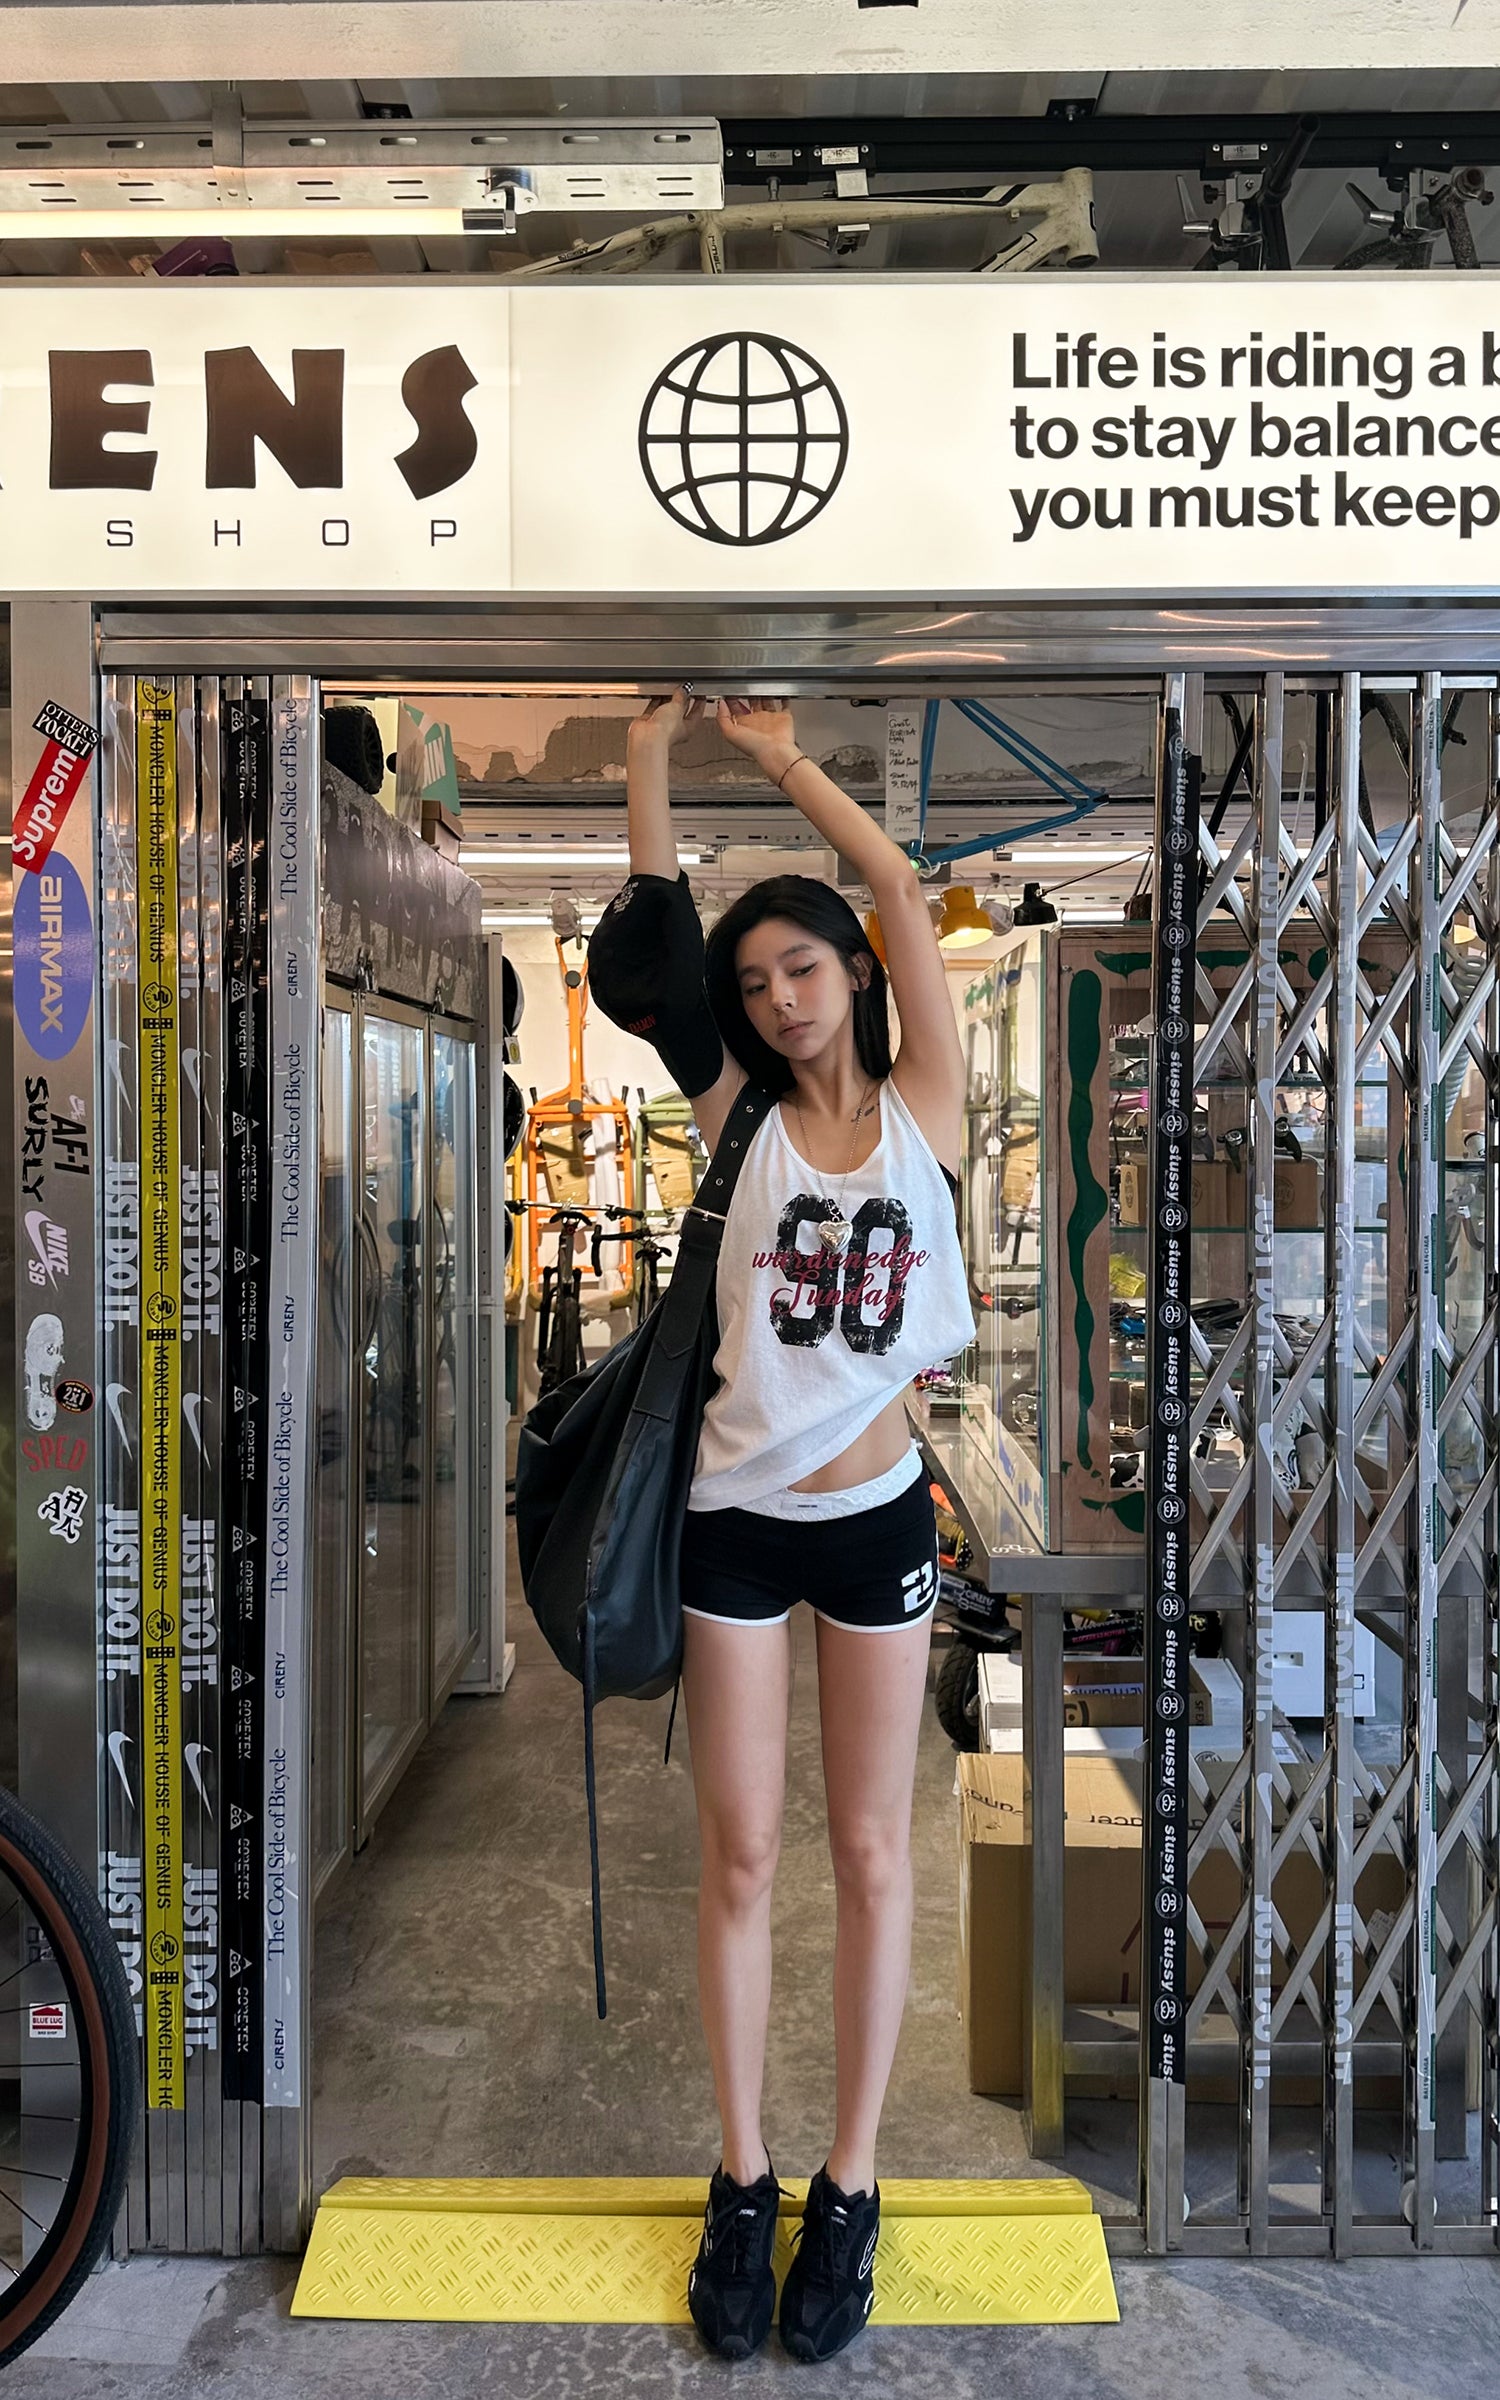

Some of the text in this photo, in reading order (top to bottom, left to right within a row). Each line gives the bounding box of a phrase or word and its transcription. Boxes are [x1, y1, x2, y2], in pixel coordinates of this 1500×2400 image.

[1012, 332, 1138, 389] Life
[1153, 332, 1206, 389] is
[1221, 331, 1413, 400] riding
[1428, 345, 1467, 388] a
[49, 345, 478, 500] ENS
[1010, 405, 1079, 459] to
[1092, 405, 1236, 470] stay
[107, 520, 457, 547] SHOP
[1009, 471, 1500, 543] you must keep
[36, 713, 93, 757] POCKET
[45, 703, 99, 744] OTTER'S
[280, 699, 301, 900] The Cool Side of Bicycle
[1173, 768, 1188, 825] stussy
[1171, 862, 1186, 920] stussy
[287, 951, 298, 995] CIRENS
[1169, 956, 1184, 1013] stussy
[1169, 1051, 1183, 1108] stussy
[21, 1075, 50, 1203] SURLY
[50, 1114, 90, 1175] AF-1
[151, 1034, 169, 1272] MONCLER HOUSE OF GENIUS
[281, 1044, 304, 1243] The Cool Side of Bicycle
[104, 1156, 139, 1232] JUST
[1167, 1144, 1182, 1201] stussy
[183, 1165, 220, 1241] JUST
[28, 1259, 46, 1287] SB
[46, 1221, 69, 1276] NIKE
[104, 1239, 139, 1290] DO
[183, 1247, 220, 1298] DO
[1166, 1239, 1181, 1298] stussy
[283, 1296, 294, 1342] CIRENS
[769, 1270, 904, 1320] Sunday
[1165, 1336, 1180, 1395] stussy
[22, 1434, 89, 1473] SPED
[152, 1346, 169, 1590] MONCLER HOUSE OF GENIUS
[1164, 1433, 1180, 1493] stussy
[271, 1392, 295, 1598] The Cool Side of Bicycle
[105, 1504, 140, 1582] JUST
[182, 1514, 218, 1592] JUST
[1163, 1531, 1178, 1591] stussy
[105, 1588, 140, 1639] DO
[182, 1598, 218, 1649] DO
[275, 1652, 286, 1699] CIRENS
[1163, 1629, 1178, 1689] stussy
[153, 1663, 171, 1909] MONCLER HOUSE OF GENIUS
[1163, 1727, 1177, 1787] stussy
[269, 1748, 289, 1961] The Cool Side of Bicycle
[1162, 1824, 1178, 1885] stussy
[183, 1863, 218, 1947] JUST
[183, 1954, 218, 2010] DO
[1161, 1927, 1176, 1992] stussy
[50, 2016, 63, 2025] LUG
[157, 1990, 173, 2080] MONCLER
[274, 2019, 285, 2070] CIRENS
